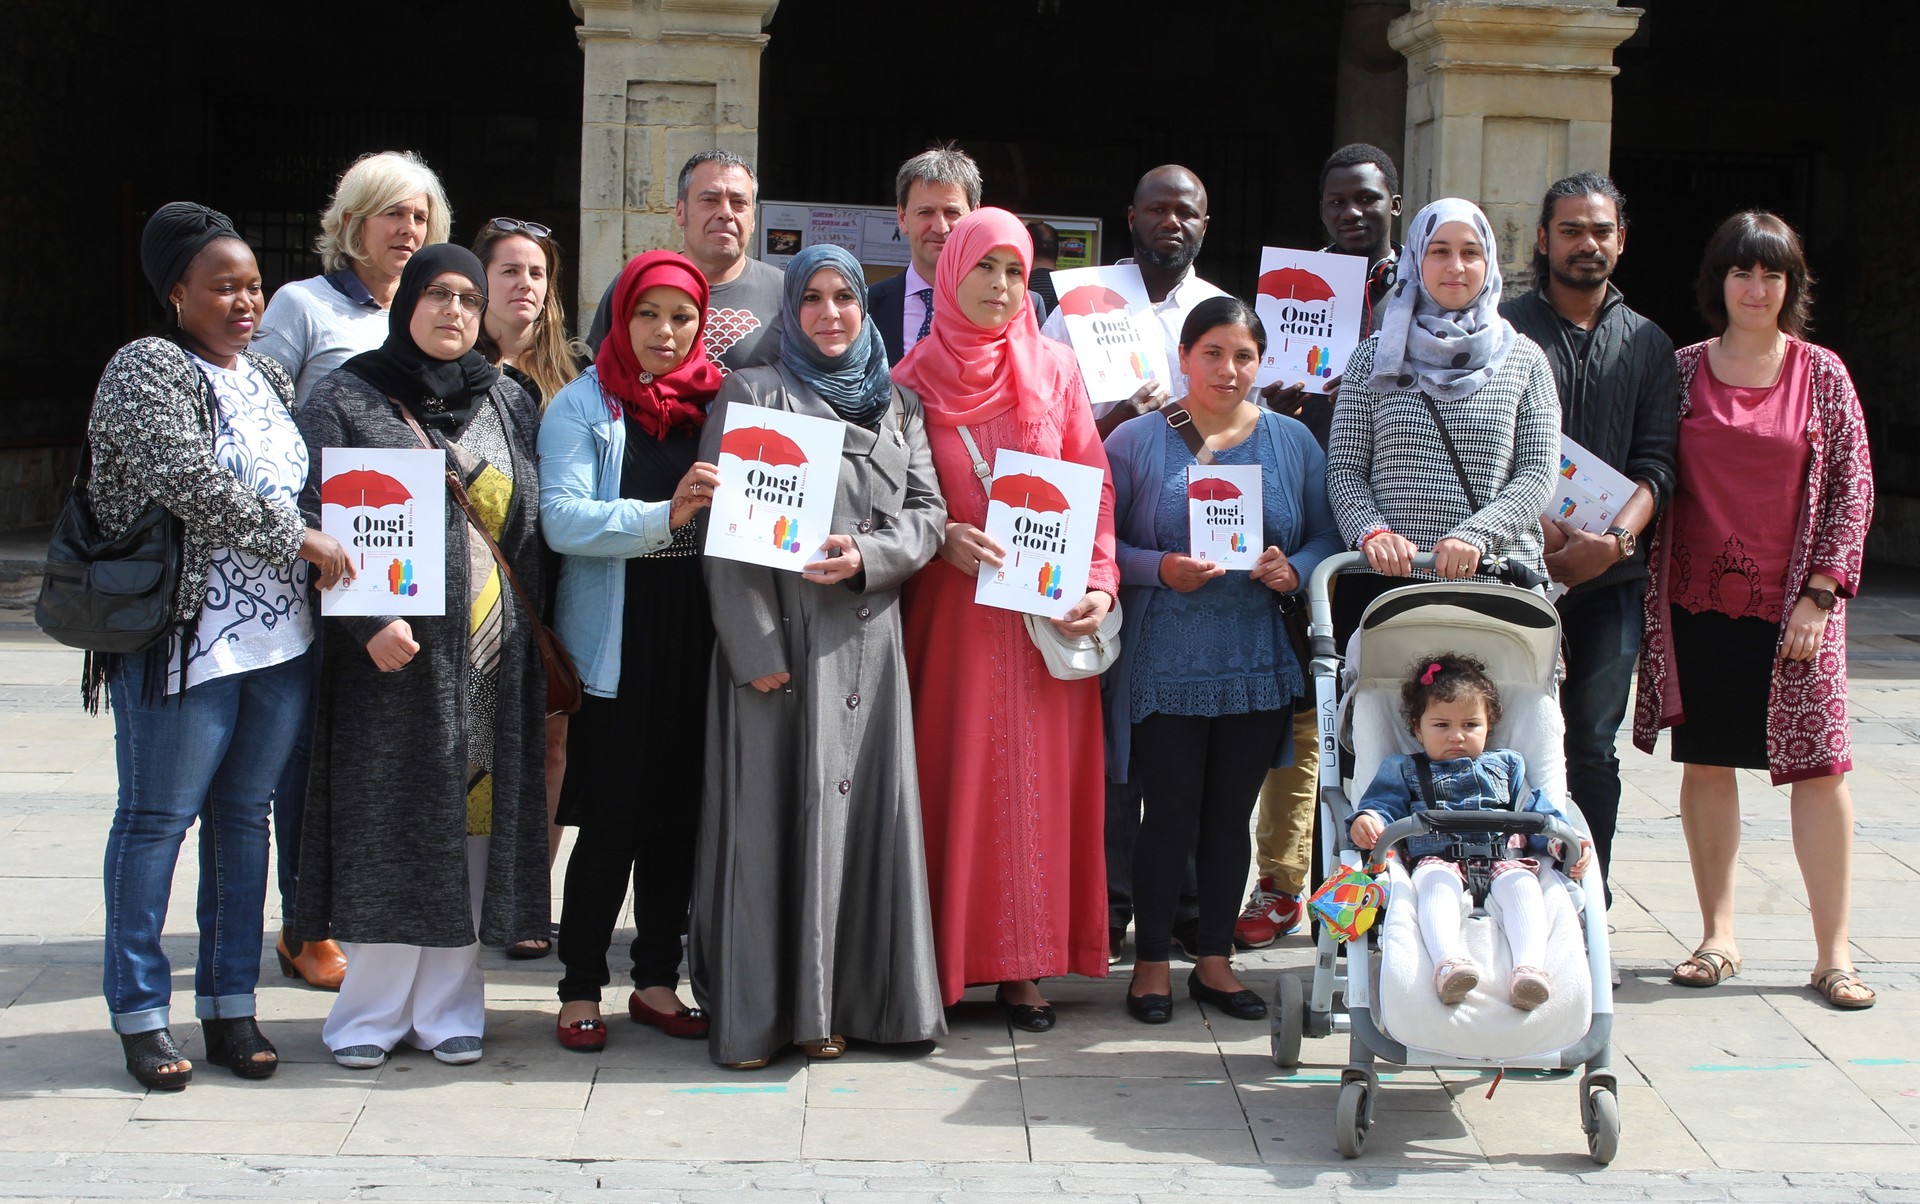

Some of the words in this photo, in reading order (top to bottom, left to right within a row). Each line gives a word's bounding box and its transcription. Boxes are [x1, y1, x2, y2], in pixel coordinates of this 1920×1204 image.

[1092, 316, 1131, 335] Ongi
[1281, 305, 1326, 327] Ongi
[1280, 322, 1333, 338] etorri
[747, 468, 798, 493] Ongi
[744, 486, 804, 508] etorri
[1206, 504, 1239, 518] Ongi
[1206, 514, 1245, 526] etorri
[353, 514, 404, 536] Ongi
[1014, 515, 1061, 540] Ongi
[353, 530, 414, 547] etorri
[1012, 533, 1067, 555] etorri
